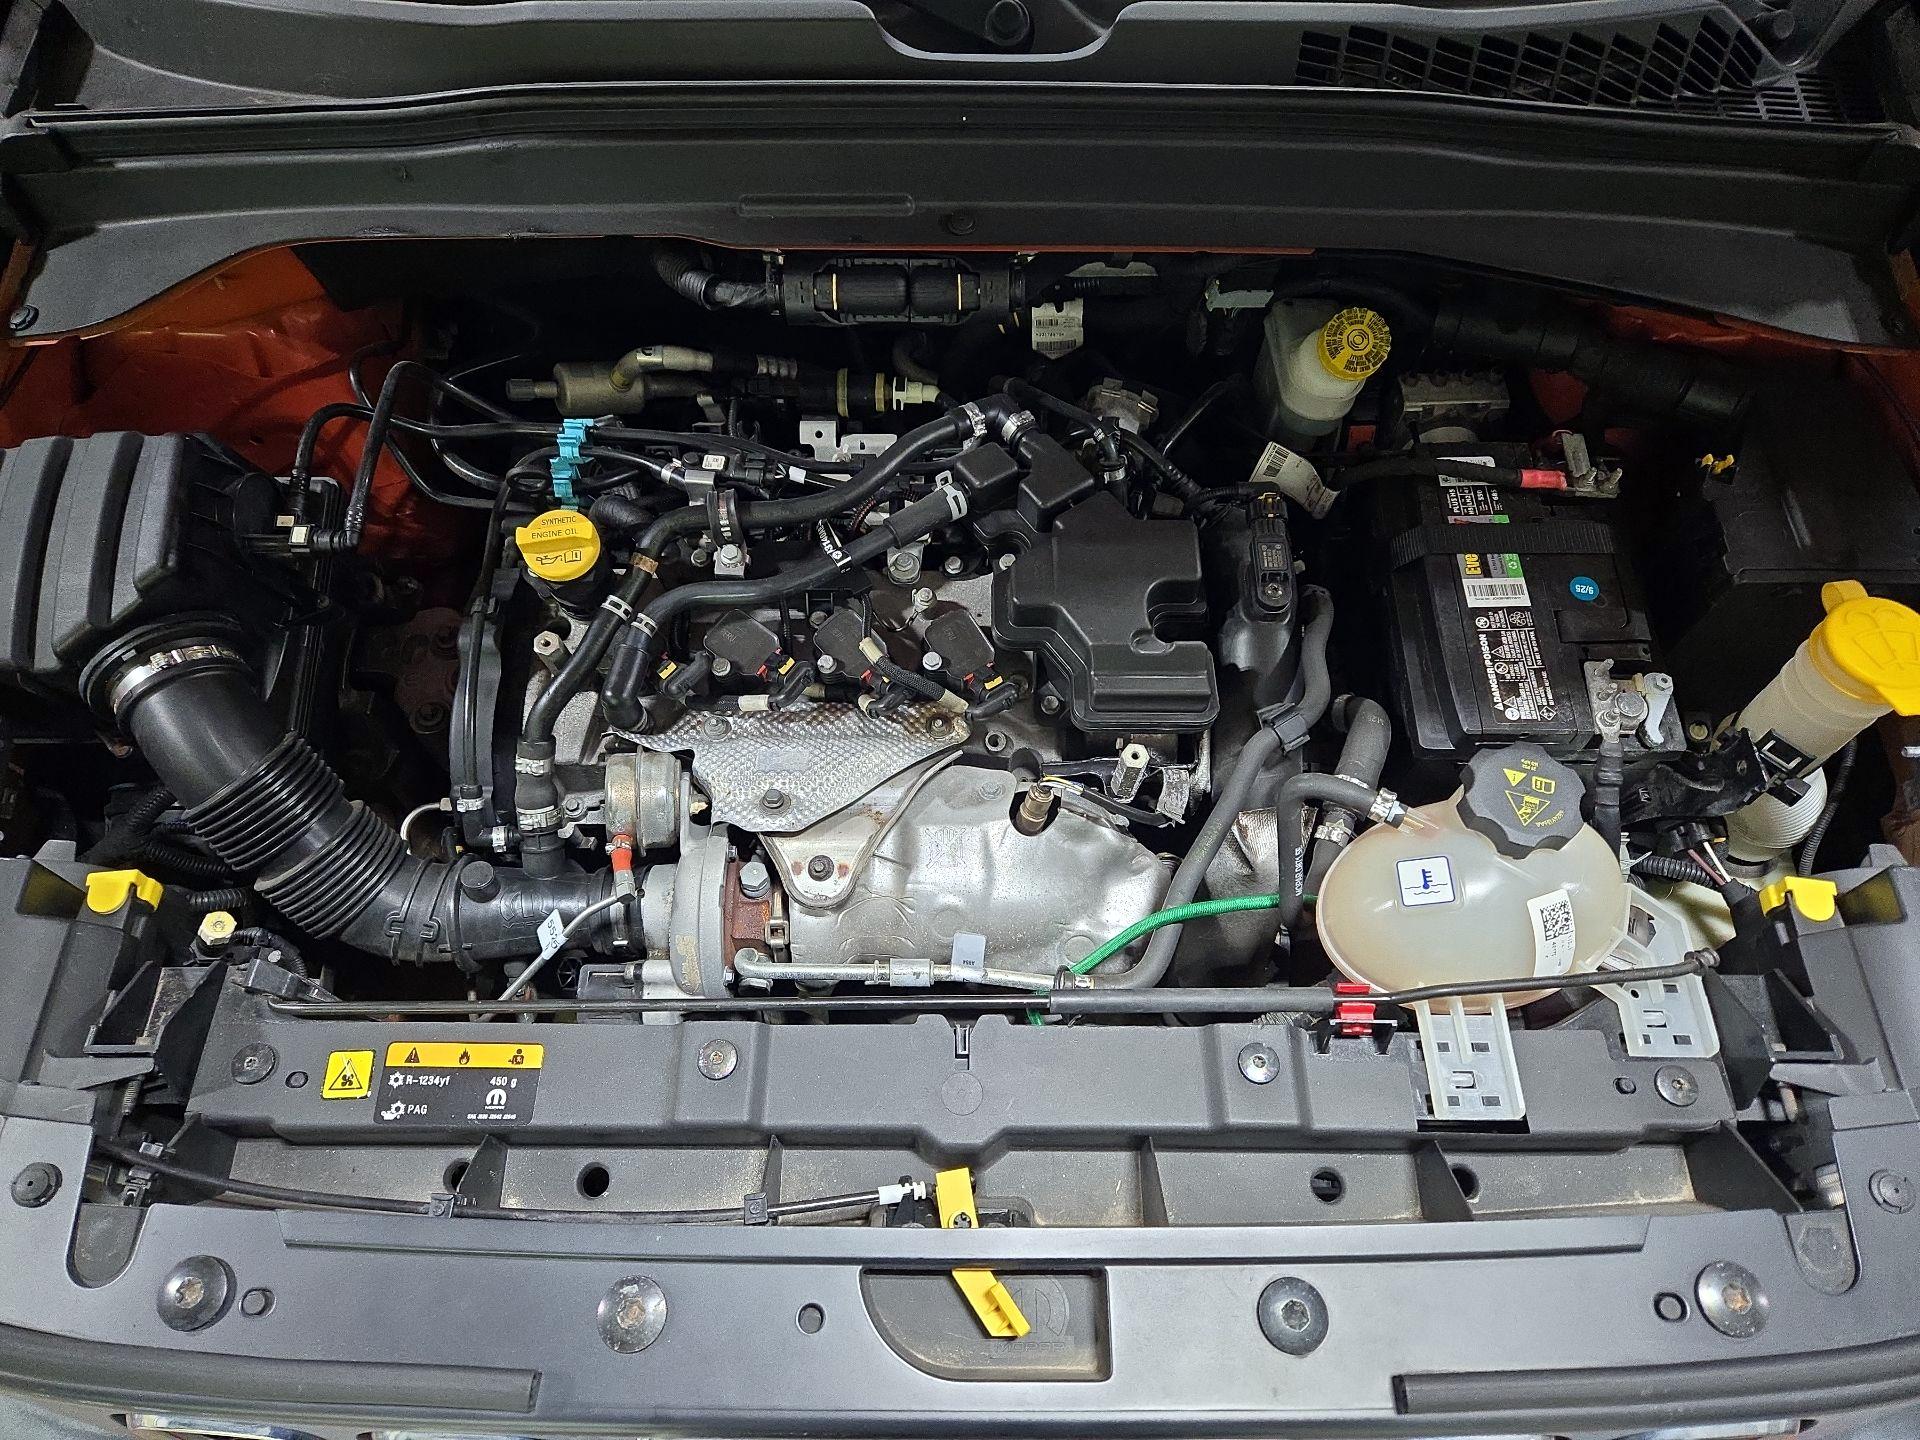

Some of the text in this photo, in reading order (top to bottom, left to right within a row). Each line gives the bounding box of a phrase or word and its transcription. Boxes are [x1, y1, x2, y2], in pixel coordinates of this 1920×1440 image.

[541, 516, 576, 526] SYNTHETIC
[531, 528, 577, 539] ENGINE OIL
[1575, 584, 1594, 595] 9/25
[405, 1074, 518, 1088] R-1234yf 450 g
[407, 1104, 428, 1115] PAG
